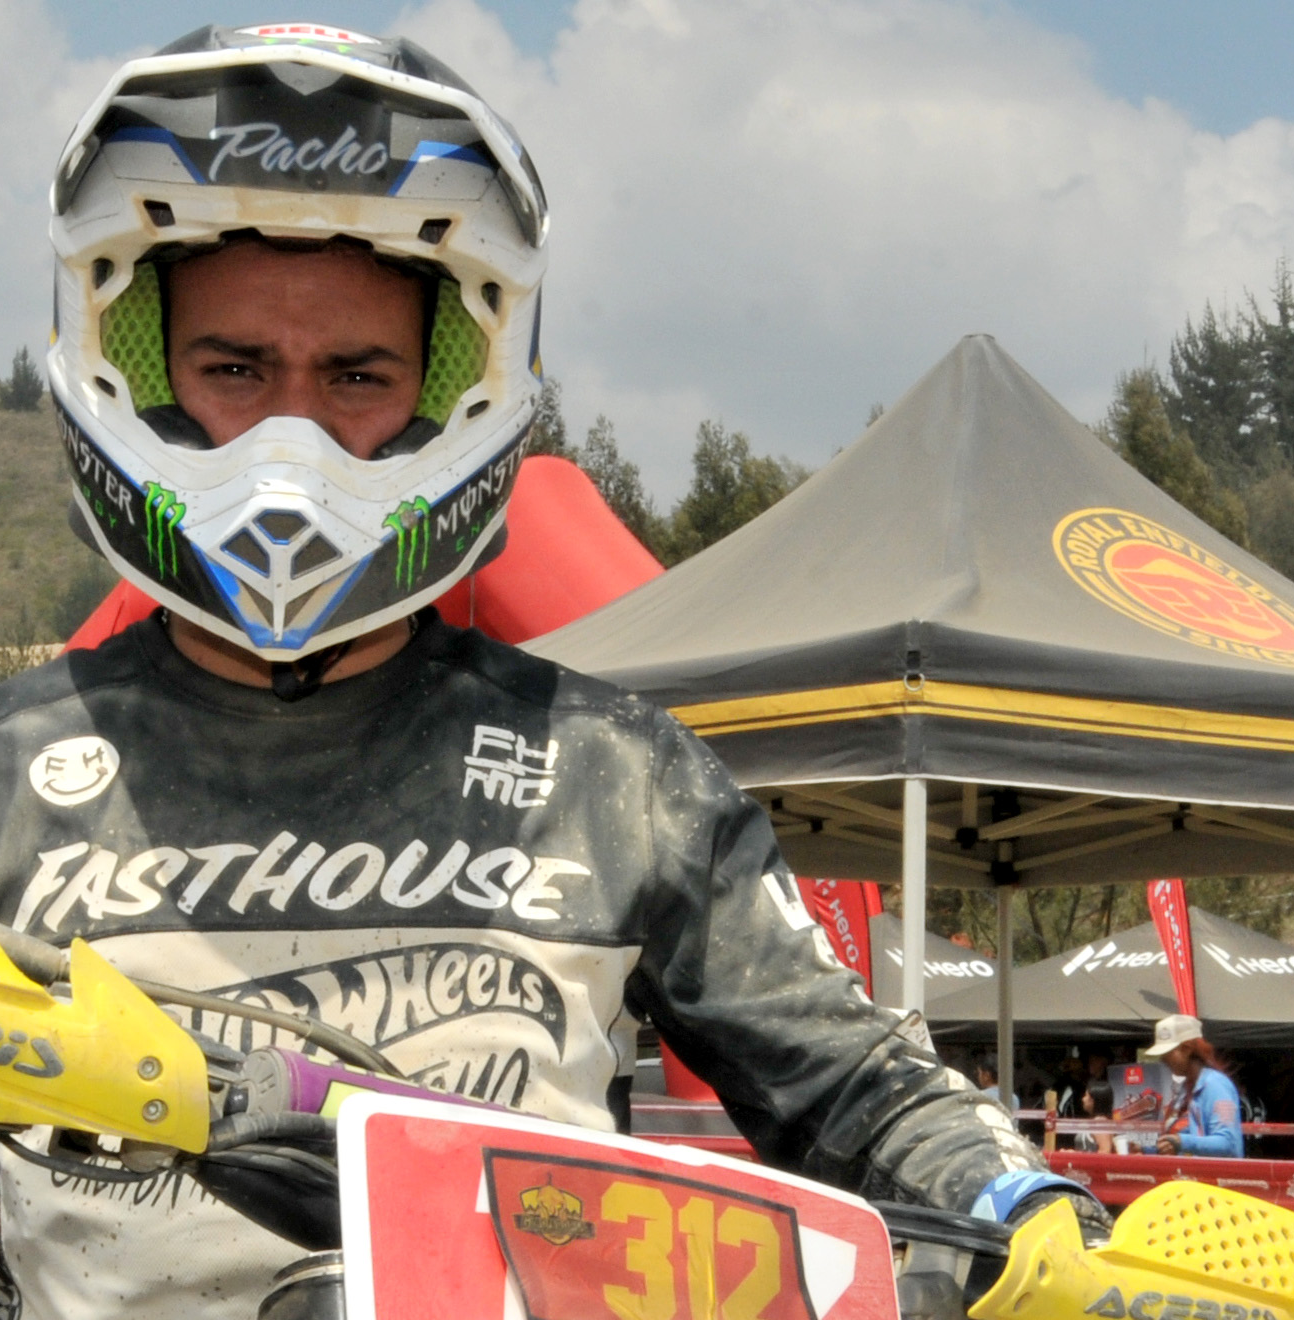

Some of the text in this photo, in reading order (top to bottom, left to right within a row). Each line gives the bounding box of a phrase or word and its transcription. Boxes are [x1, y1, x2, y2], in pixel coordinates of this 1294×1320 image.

[208, 121, 389, 182] Pacho
[1066, 515, 1272, 602] ROYAL ENFIELD
[10, 830, 592, 934] FASTHOUSE
[828, 897, 860, 964] Hero
[929, 959, 995, 978] Hero
